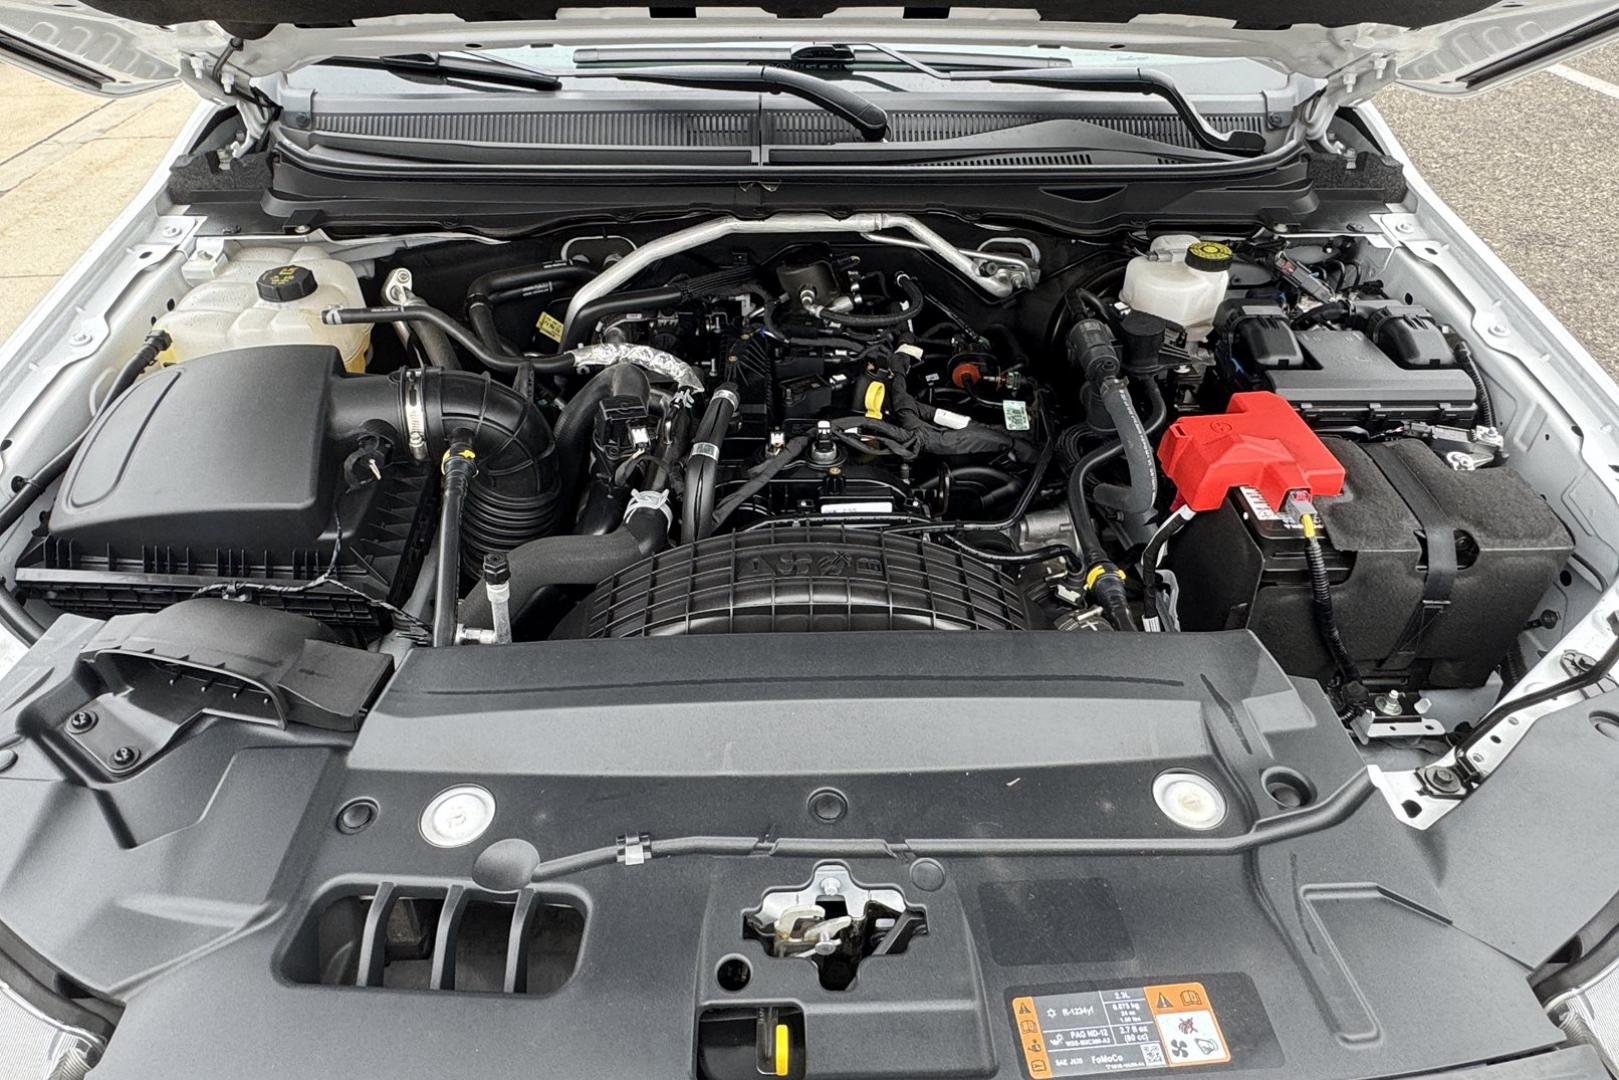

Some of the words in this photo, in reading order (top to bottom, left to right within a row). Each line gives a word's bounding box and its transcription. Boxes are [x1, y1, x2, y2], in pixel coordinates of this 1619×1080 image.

[1062, 1006, 1095, 1016] R-1234yf
[1120, 1026, 1131, 1035] 2.7
[1091, 1054, 1123, 1065] FoMoCo
